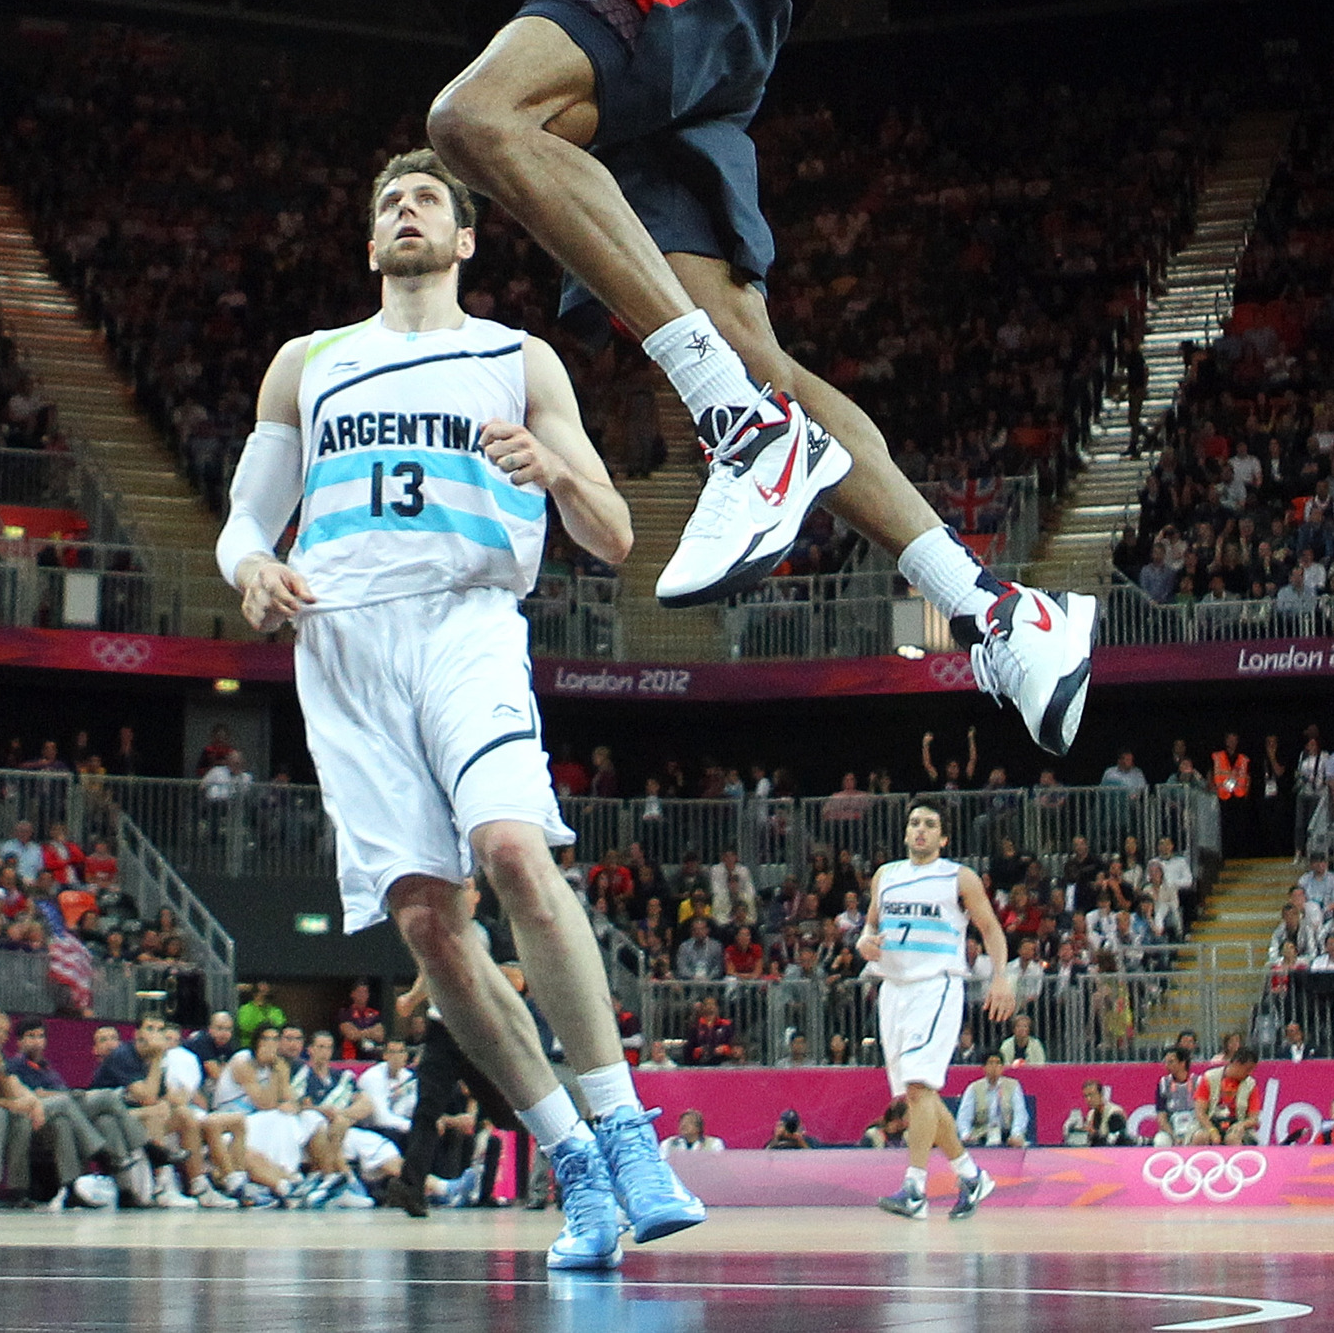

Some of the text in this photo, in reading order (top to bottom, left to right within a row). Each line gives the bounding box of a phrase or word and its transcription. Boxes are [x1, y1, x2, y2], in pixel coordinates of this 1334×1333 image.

[370, 460, 425, 518] 13
[1237, 644, 1324, 672] London
[554, 666, 691, 693] London 2012
[898, 921, 911, 945] 7
